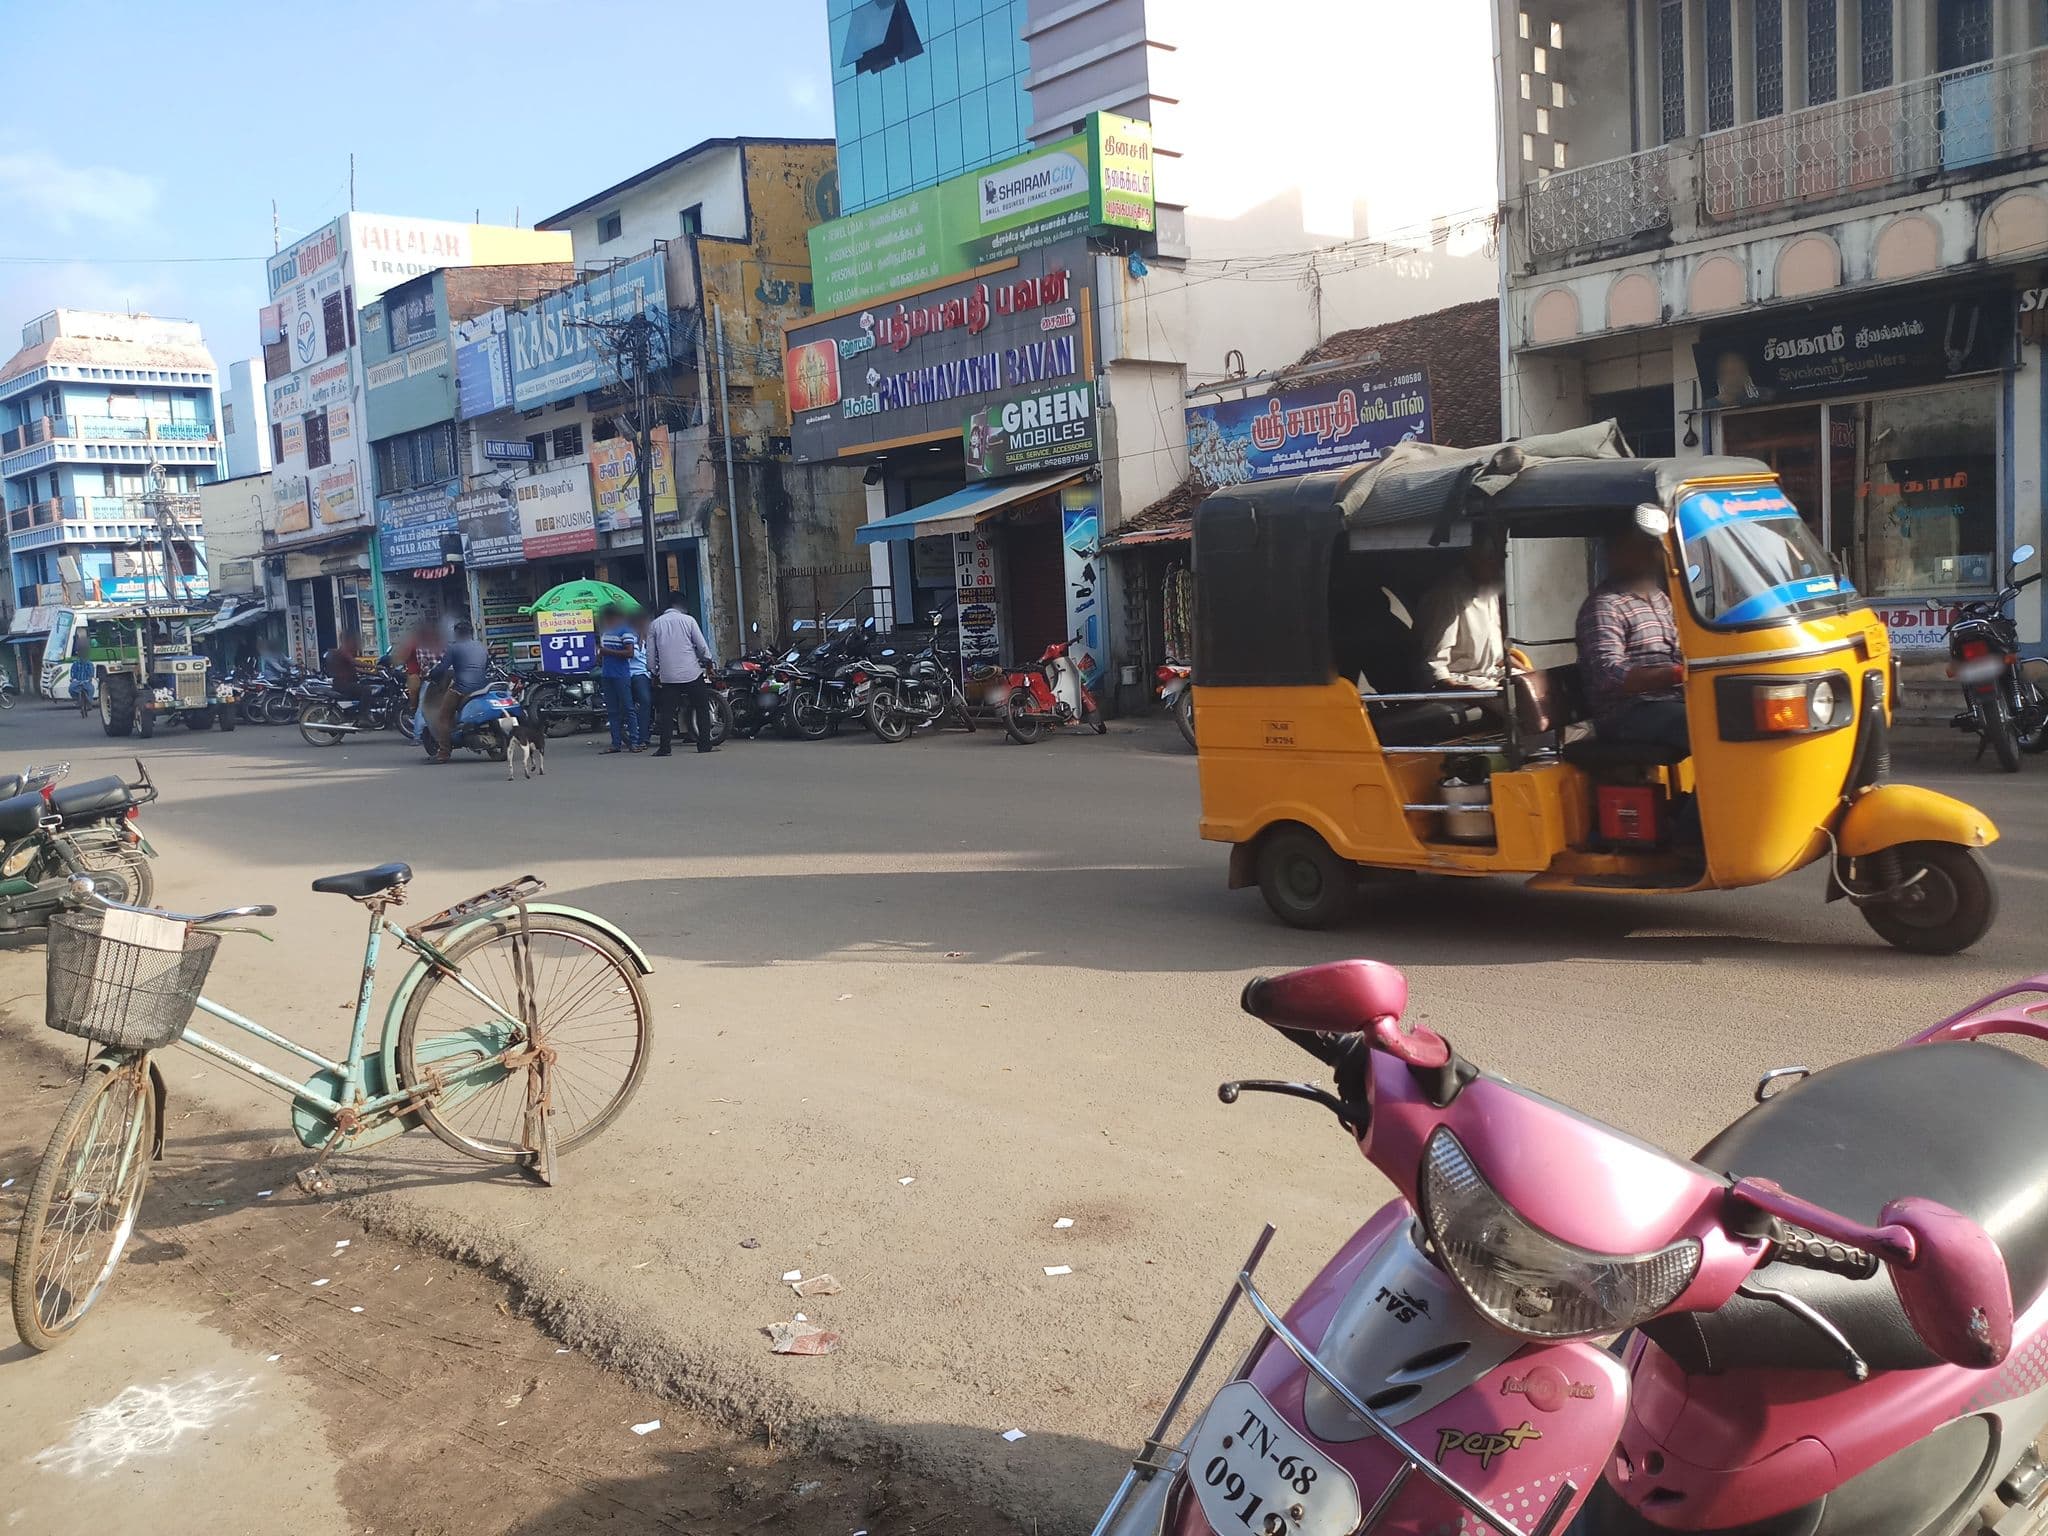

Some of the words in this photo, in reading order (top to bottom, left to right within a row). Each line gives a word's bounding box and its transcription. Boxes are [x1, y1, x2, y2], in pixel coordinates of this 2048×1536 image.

[1105, 136, 1148, 160] தினசரி
[999, 170, 1051, 200] SHRIRAM
[1052, 165, 1077, 183] City
[1050, 183, 1073, 195] COMPANY
[876, 283, 990, 352] பத்மாவதி
[843, 393, 880, 419] Hotel
[880, 352, 1001, 412] PATHMAVATHI
[1005, 335, 1076, 387] BAVAN
[1002, 388, 1089, 433] GREEN
[1252, 398, 1286, 451] ஸ்ரீ
[1286, 388, 1360, 444] சாரதி
[1360, 390, 1425, 425] ஸ்டோர்ஸ்
[487, 442, 505, 456] RASEE
[1010, 421, 1085, 450] MOBILES
[1015, 460, 1041, 472] KARTHIK
[556, 511, 592, 529] HOUSING
[549, 635, 587, 650] சா
[1374, 1286, 1418, 1325] TVS
[1236, 1408, 1318, 1495] TN-68
[1436, 1420, 1542, 1472] pep+
